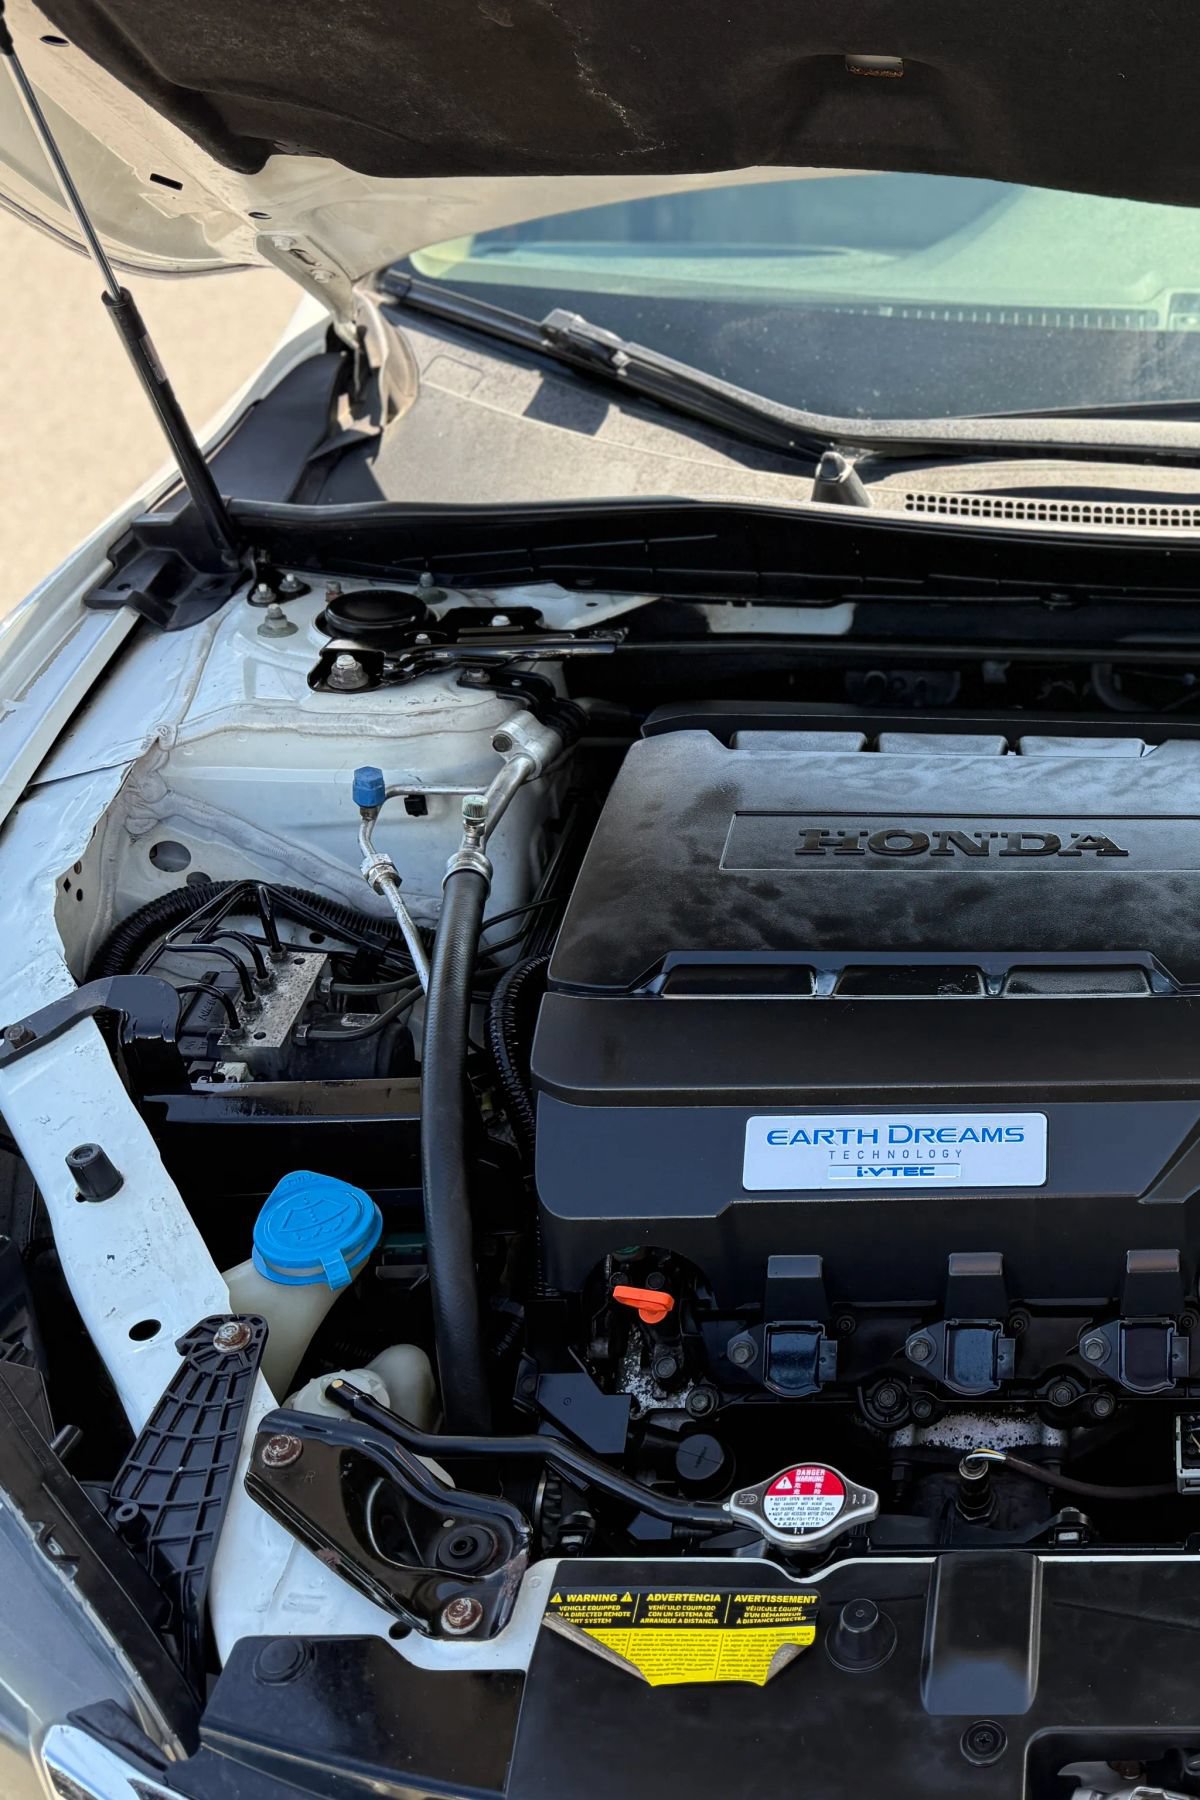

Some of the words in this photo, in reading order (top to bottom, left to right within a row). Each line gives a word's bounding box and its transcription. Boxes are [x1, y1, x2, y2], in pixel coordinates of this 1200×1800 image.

[795, 828, 1129, 856] HONDA
[767, 1128, 878, 1146] EARTH
[829, 1149, 962, 1160] TECHNOLOGY
[856, 1166, 935, 1178] i-VTEC
[566, 1594, 617, 1602] WARNING
[646, 1594, 720, 1602] ADVERTENCIA
[734, 1594, 818, 1604] AVERTISSEMENT
